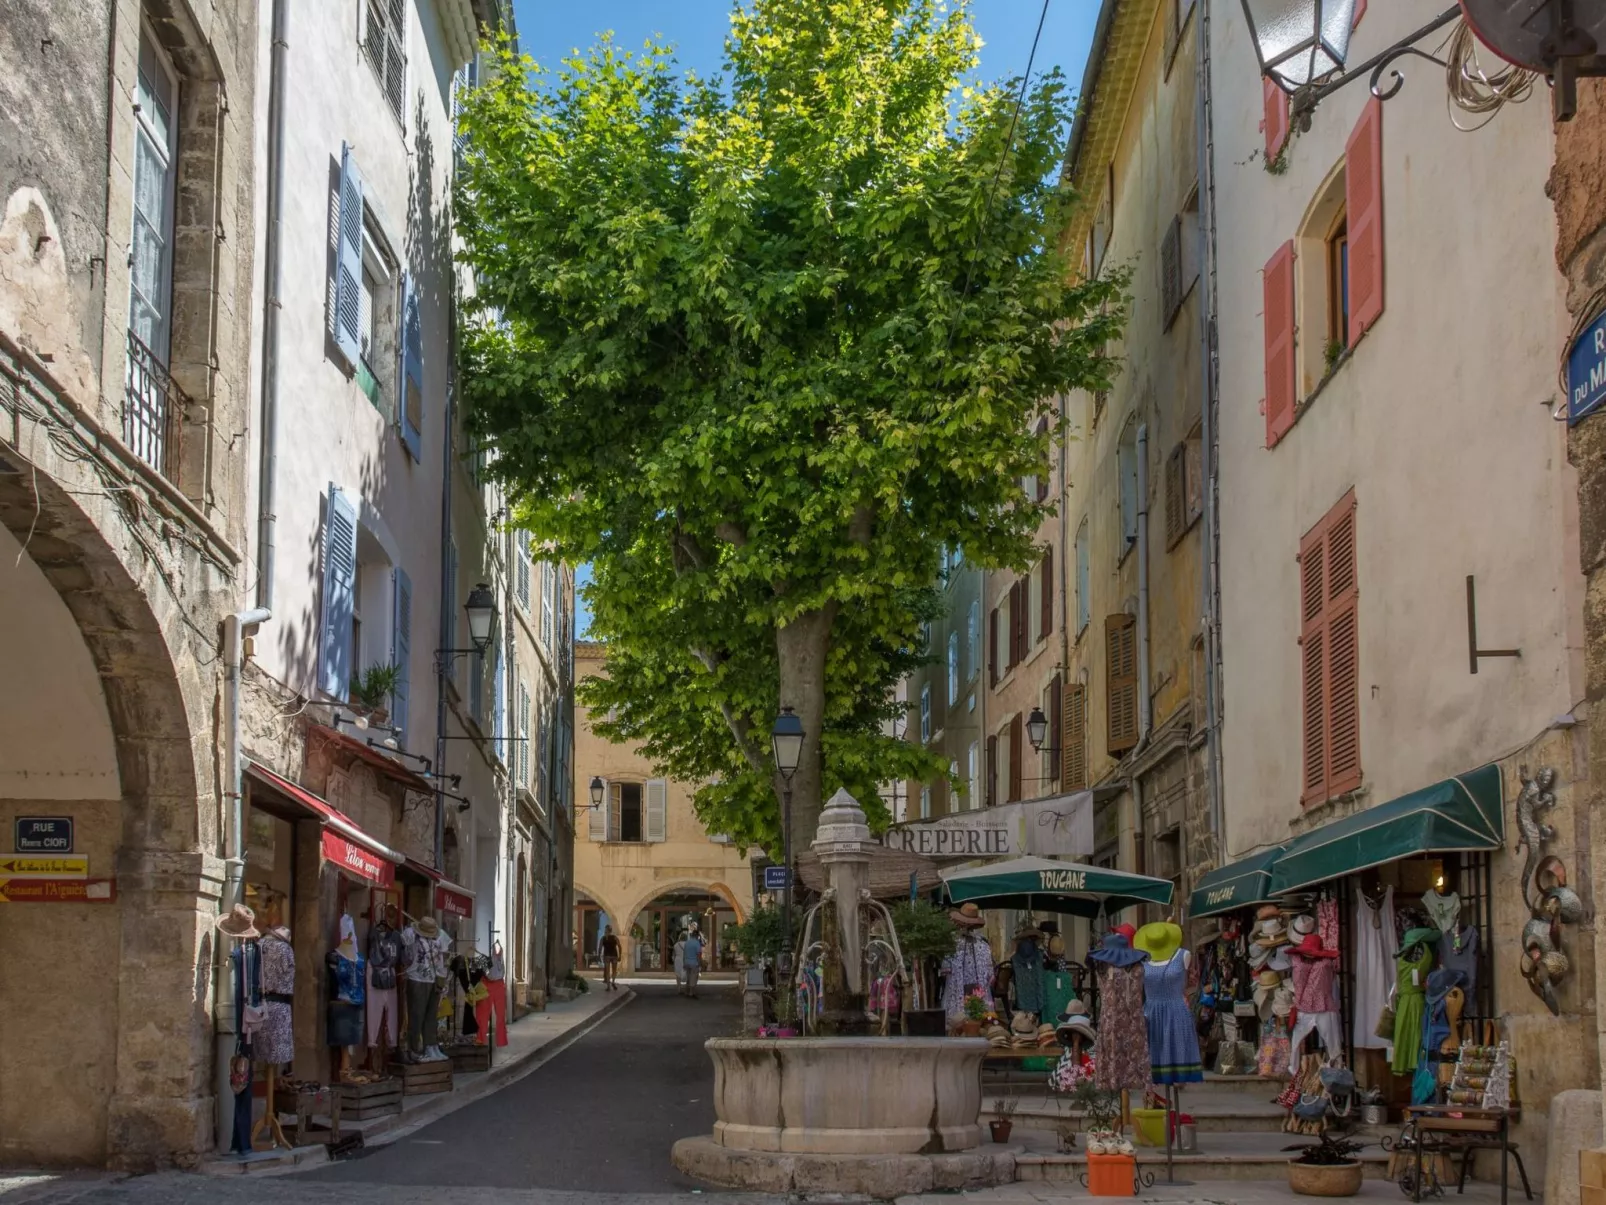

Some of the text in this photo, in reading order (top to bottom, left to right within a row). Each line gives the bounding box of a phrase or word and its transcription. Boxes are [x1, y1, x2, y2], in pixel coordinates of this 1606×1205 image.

[1575, 382, 1588, 405] DU
[33, 823, 55, 832] RUE
[886, 828, 1010, 854] CREPERIE
[1039, 870, 1086, 890] TOUCANE
[1206, 885, 1236, 906] TOUCANE
